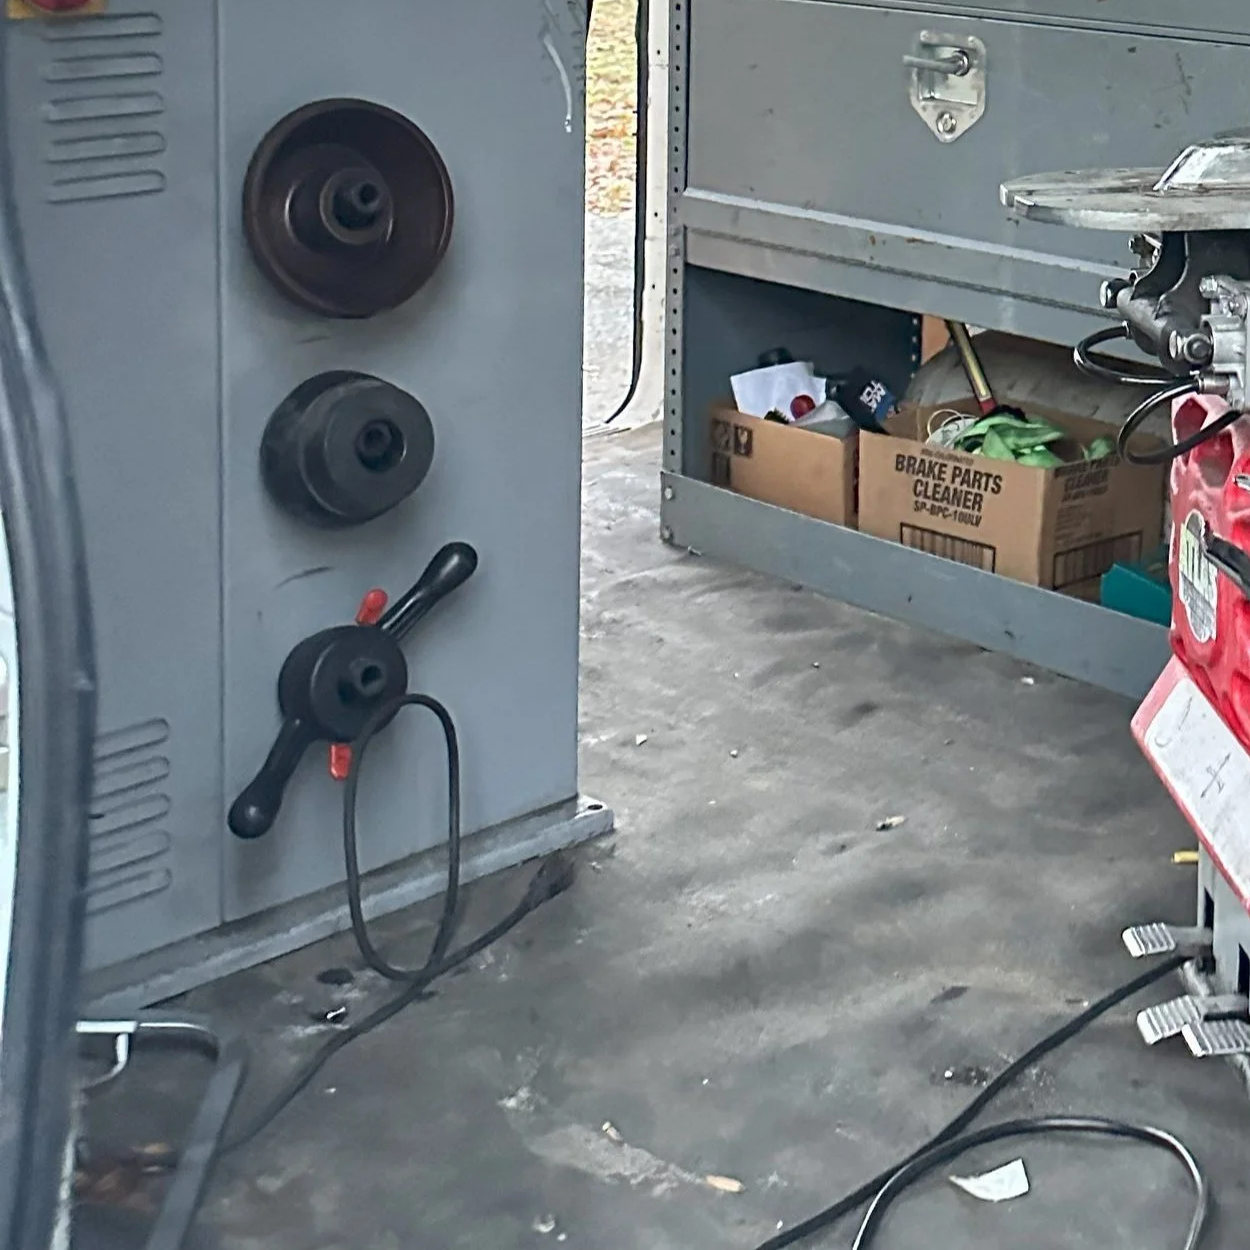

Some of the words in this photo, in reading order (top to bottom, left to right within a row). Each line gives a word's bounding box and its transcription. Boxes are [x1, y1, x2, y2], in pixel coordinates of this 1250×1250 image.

[895, 454, 947, 483] BRAKE
[951, 466, 1003, 495] PARTS
[913, 479, 984, 512] CLEANER
